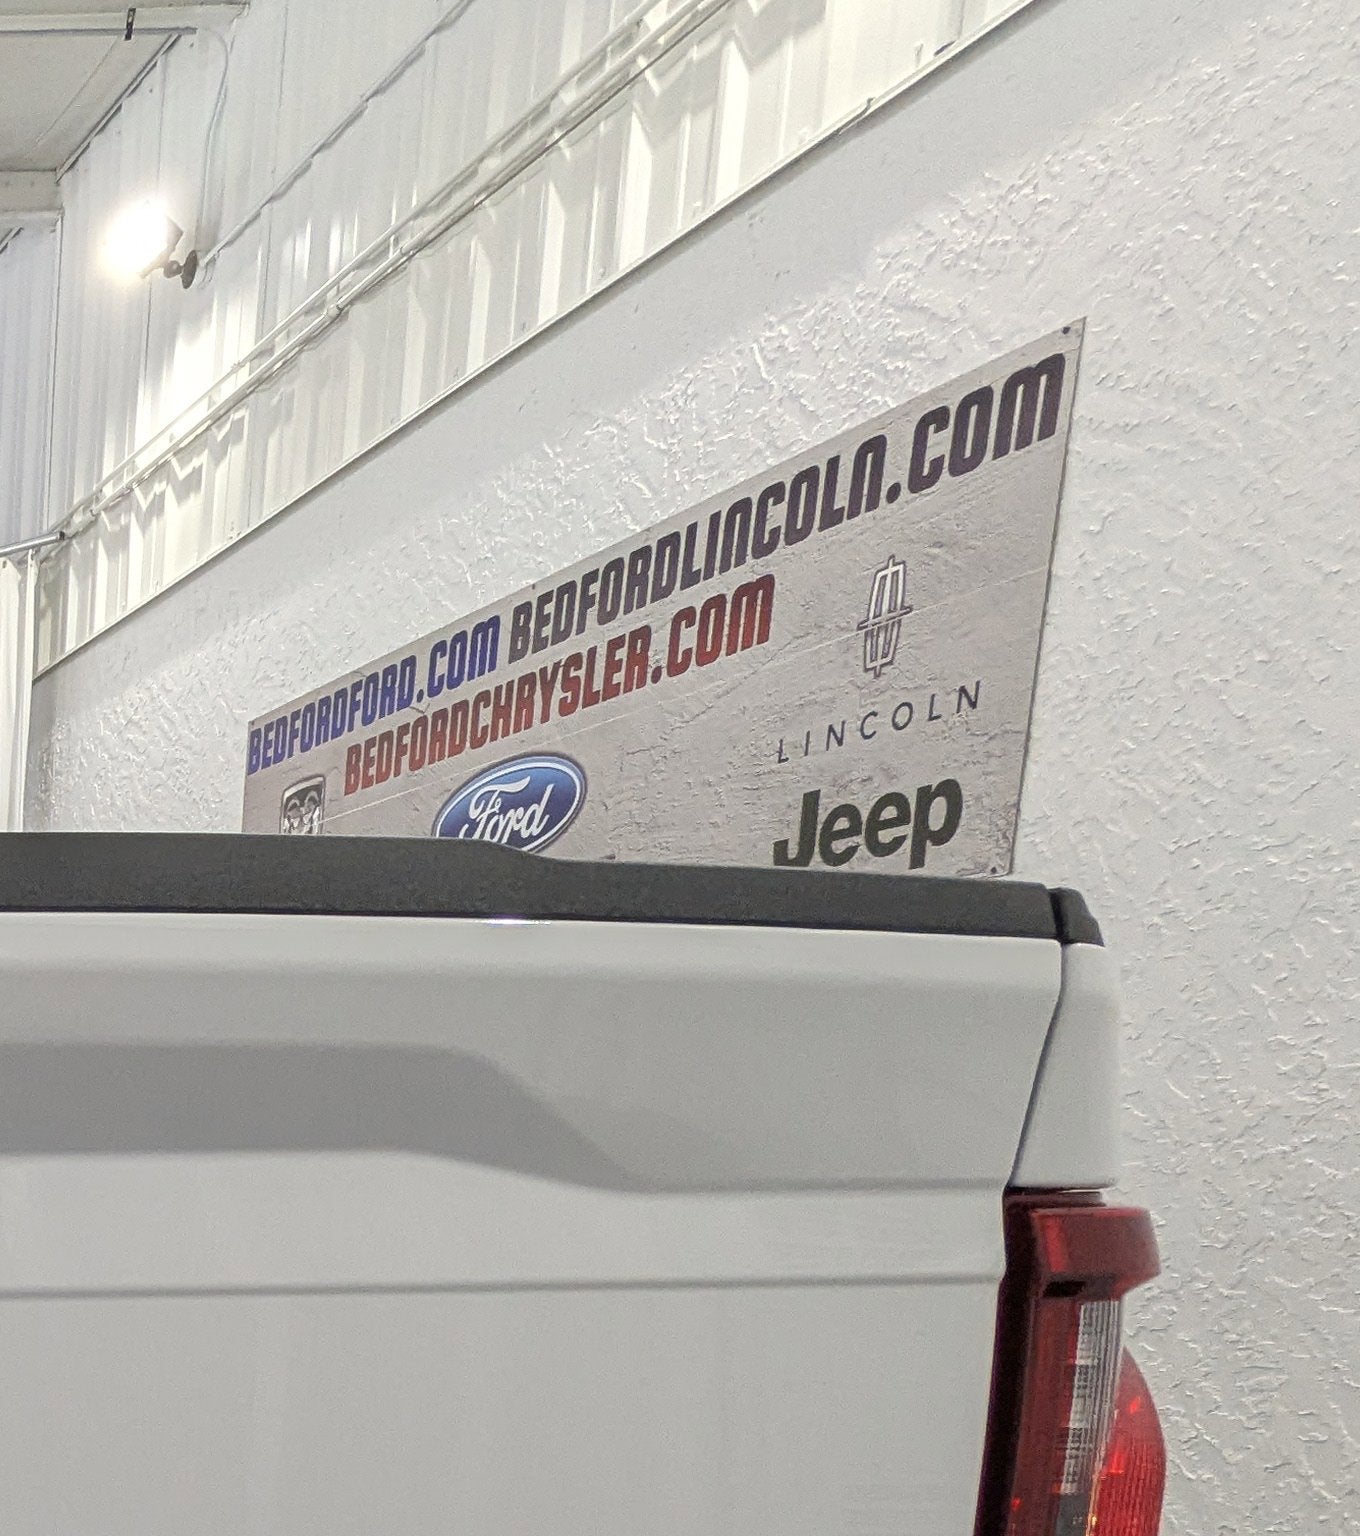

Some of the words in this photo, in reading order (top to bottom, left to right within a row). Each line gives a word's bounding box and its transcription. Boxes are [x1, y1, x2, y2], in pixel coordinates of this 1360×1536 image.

[248, 615, 501, 775] BEDFORDFORD.COM
[508, 353, 1065, 664] BEDFORDLINCOLN.COM
[344, 573, 775, 796] BEDFORDCHRYSLER.COM
[778, 680, 980, 764] LINCOLN
[458, 776, 555, 844] Ford
[773, 778, 963, 869] Jeep
